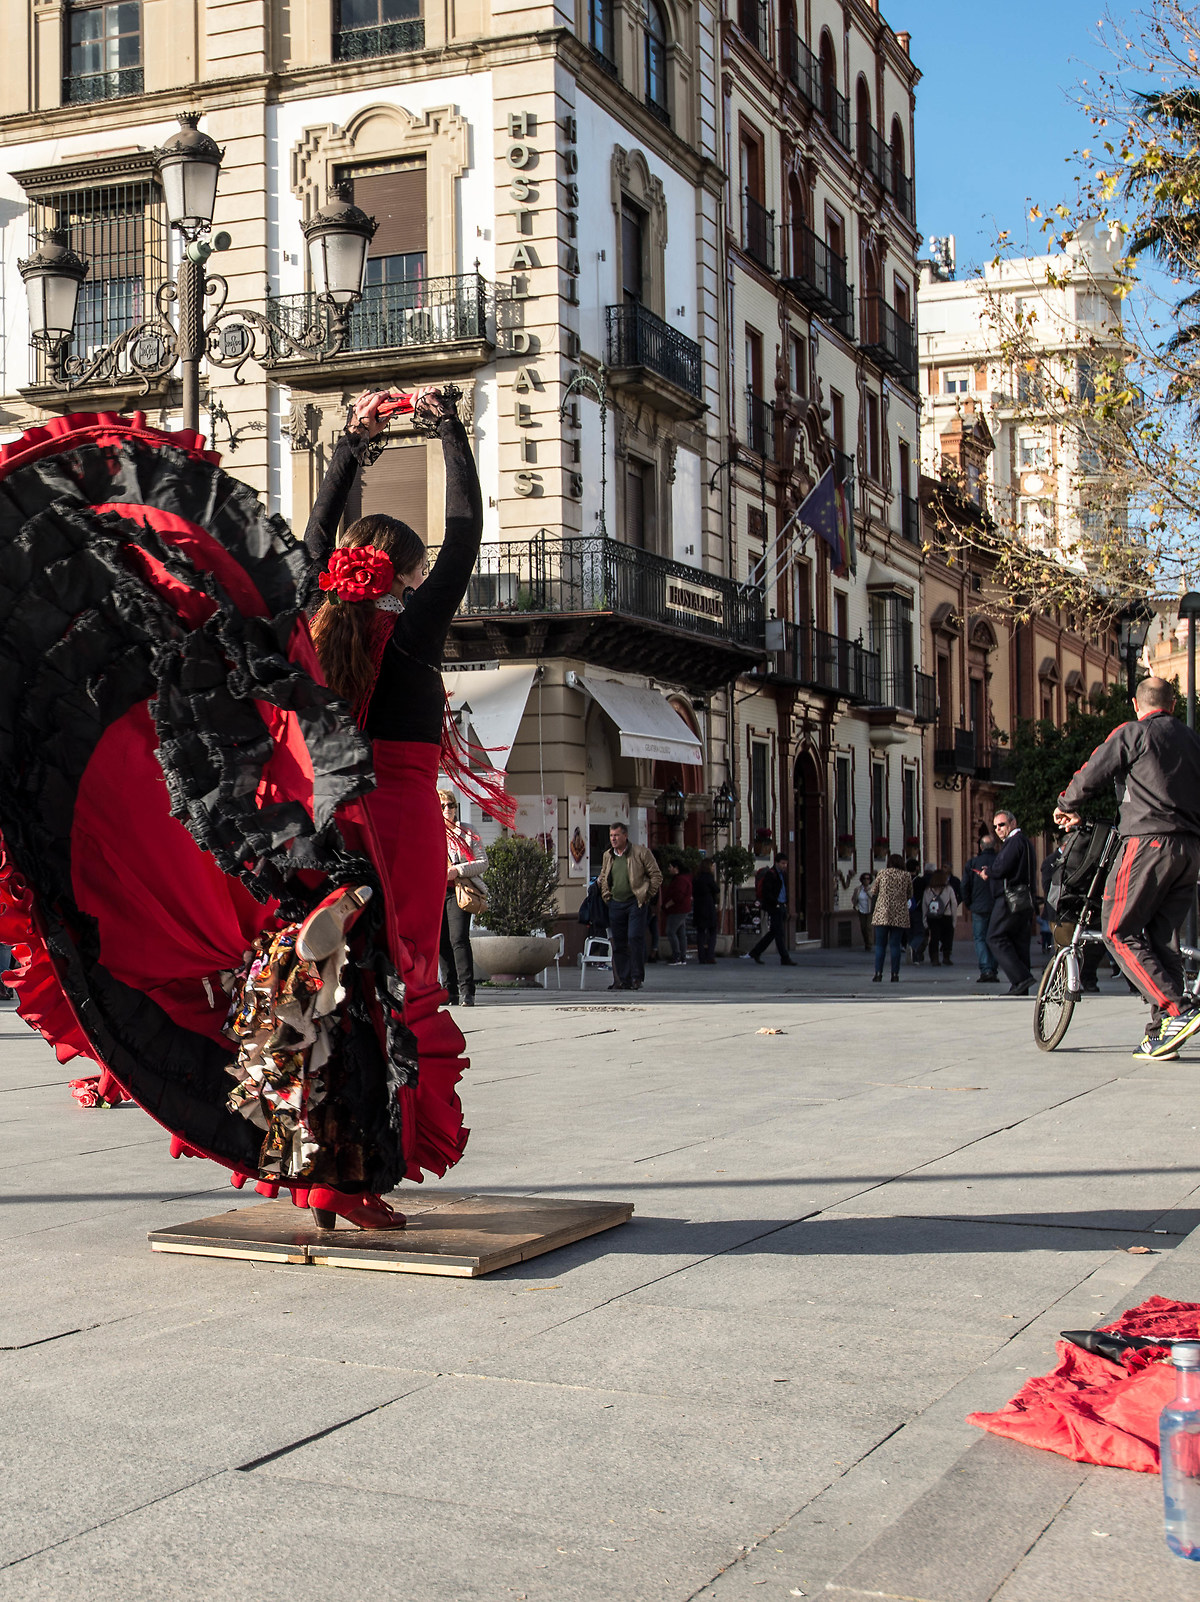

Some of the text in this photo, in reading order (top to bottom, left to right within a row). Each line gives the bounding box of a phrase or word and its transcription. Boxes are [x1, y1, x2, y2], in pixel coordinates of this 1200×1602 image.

[506, 111, 535, 496] HOSTAL DALIS
[565, 116, 580, 307] HOSTAL
